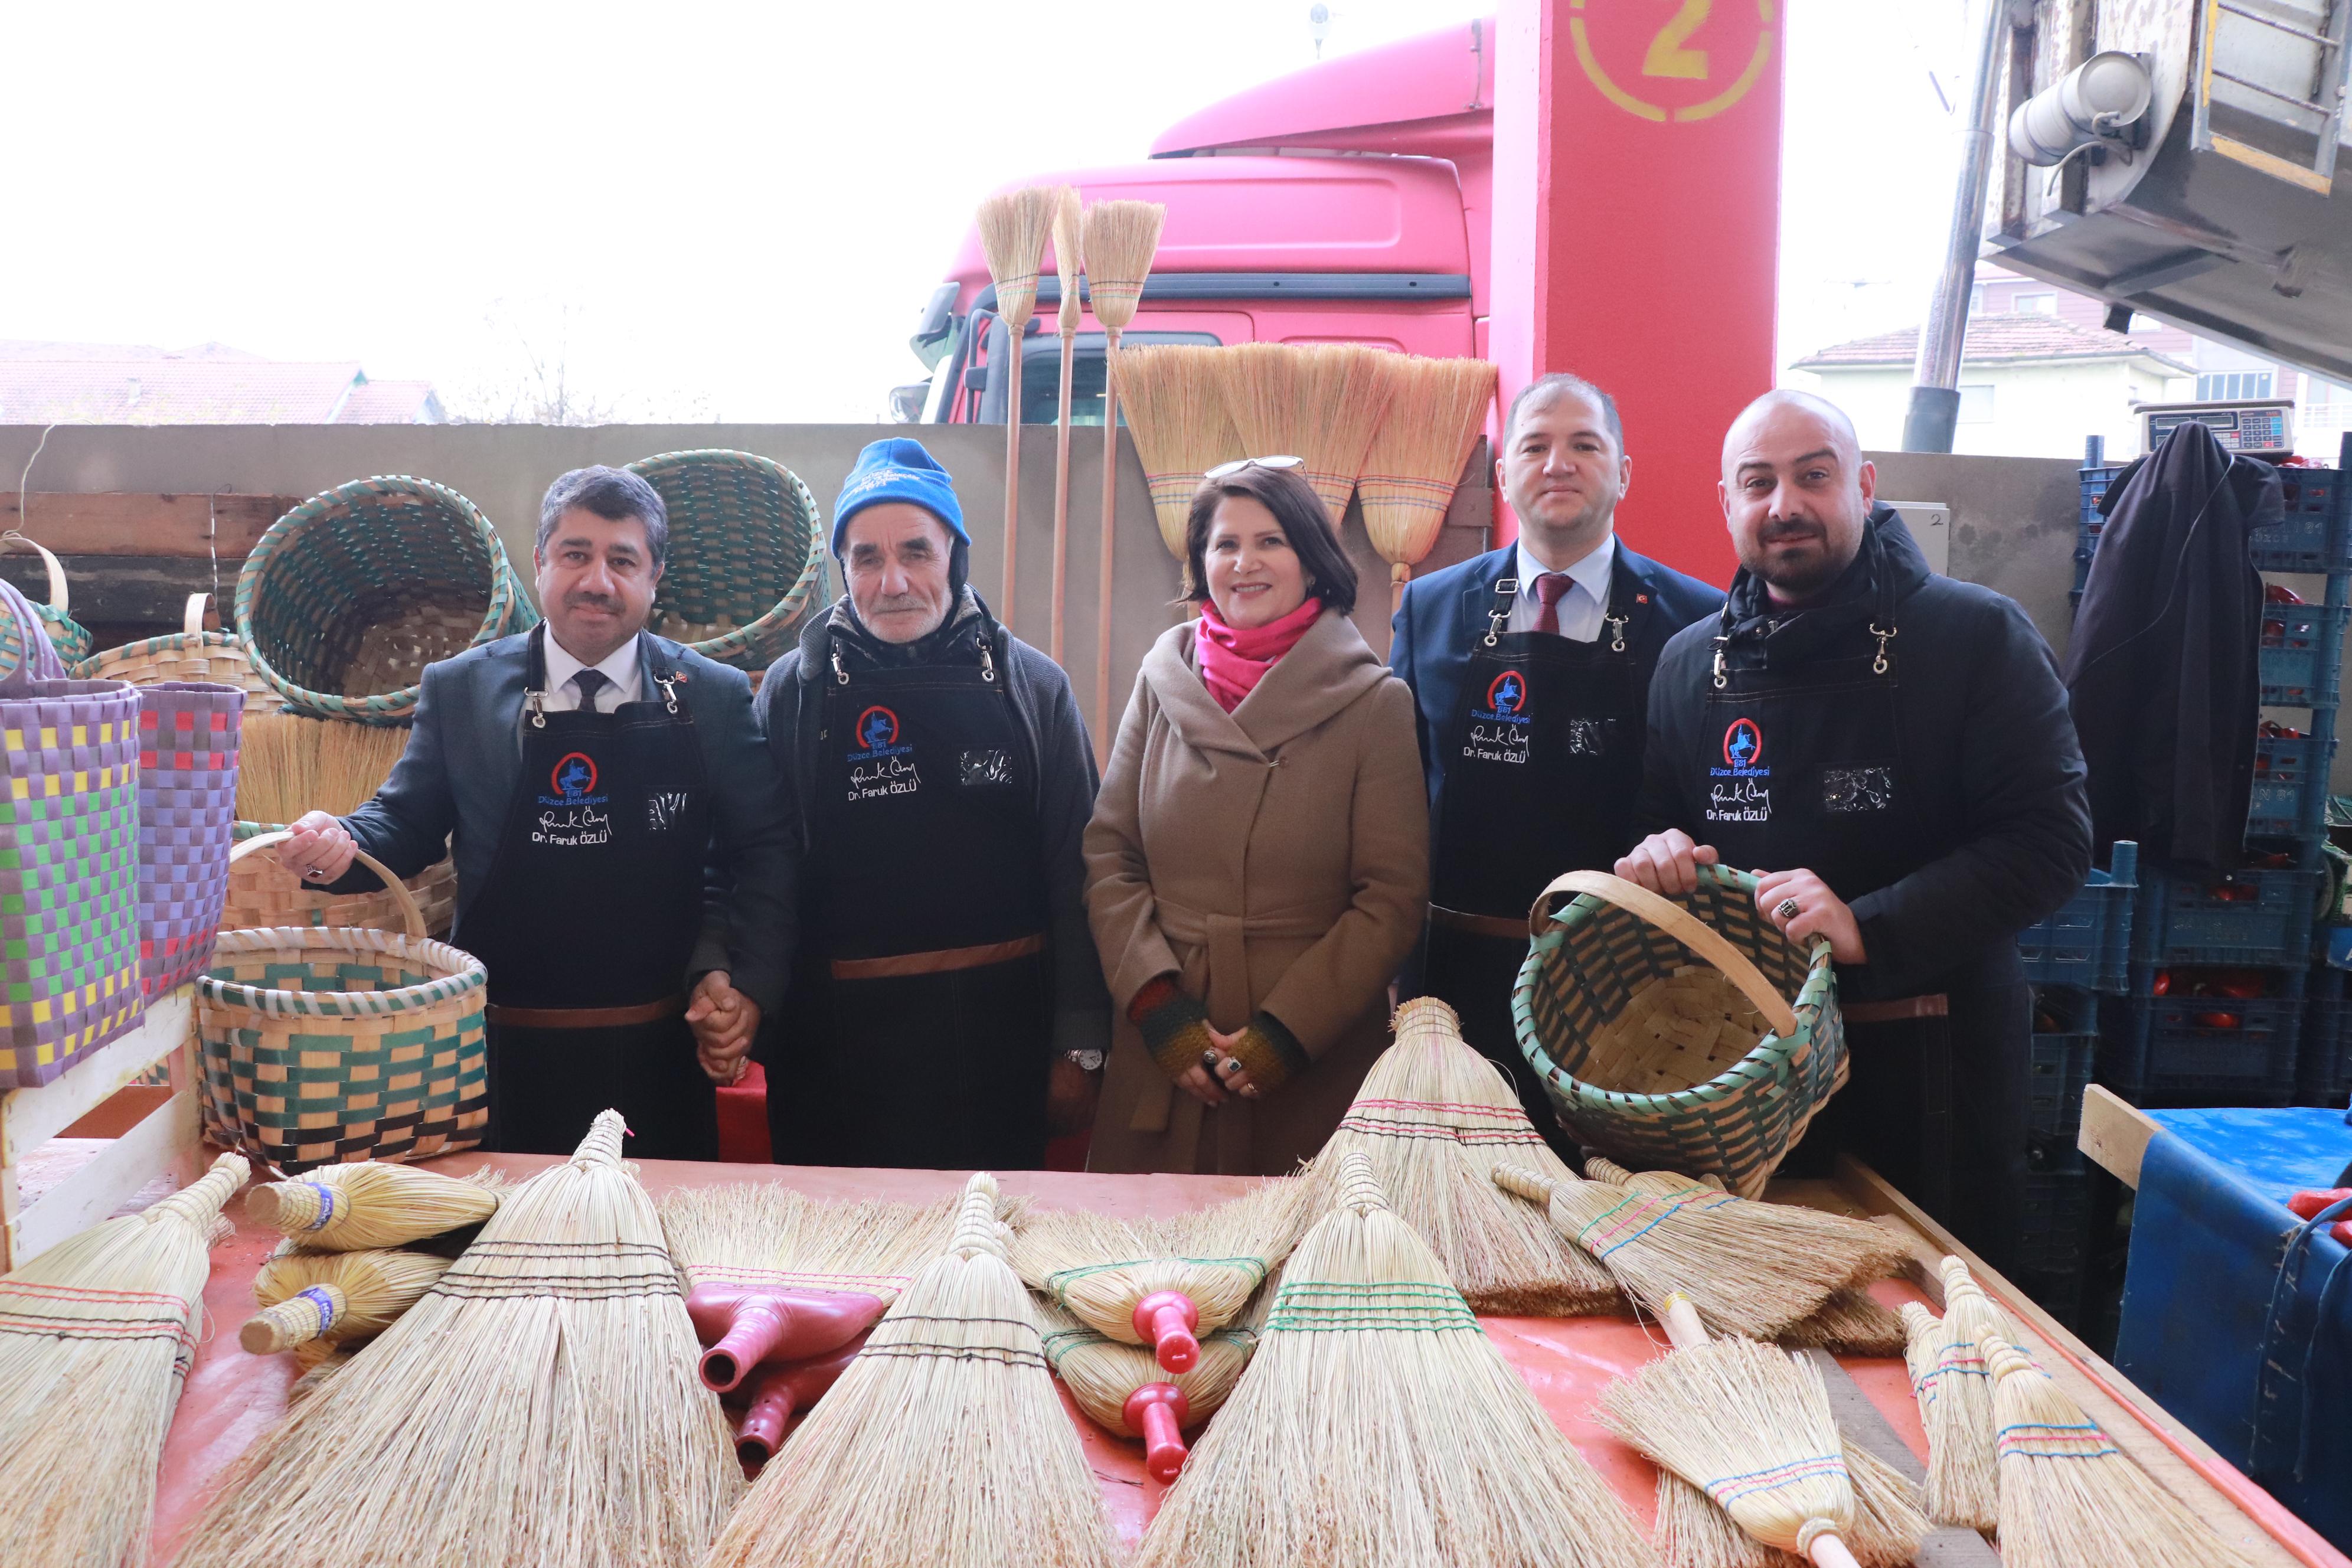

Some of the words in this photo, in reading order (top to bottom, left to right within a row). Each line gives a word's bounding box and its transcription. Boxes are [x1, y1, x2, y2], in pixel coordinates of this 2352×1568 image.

[1930, 514, 1944, 526] 2
[1471, 709, 1494, 720] Düzce
[1495, 713, 1530, 724] Belediyesi
[847, 753, 870, 762] Düzce
[873, 744, 912, 757] Belediyesi
[1464, 747, 1476, 757] Dr.
[1478, 749, 1502, 761] Faruk
[1504, 749, 1525, 763] ÖZLÜ
[1710, 767, 1732, 776] Düzce
[1733, 766, 1770, 777] Belediyesi
[848, 792, 861, 801] Dr.
[862, 786, 888, 798] Faruk
[890, 779, 917, 793] ÖZLÜ
[2276, 789, 2295, 801] 81
[538, 796, 564, 806] Düzce
[566, 795, 609, 805] Belediyesi
[1706, 809, 1718, 821] Dr.
[1719, 810, 1742, 821] Faruk
[1743, 806, 1768, 821] ÖZLÜ
[532, 832, 547, 843] Dr.
[550, 834, 578, 845] Faruk
[580, 829, 607, 844] ÖZLÜ
